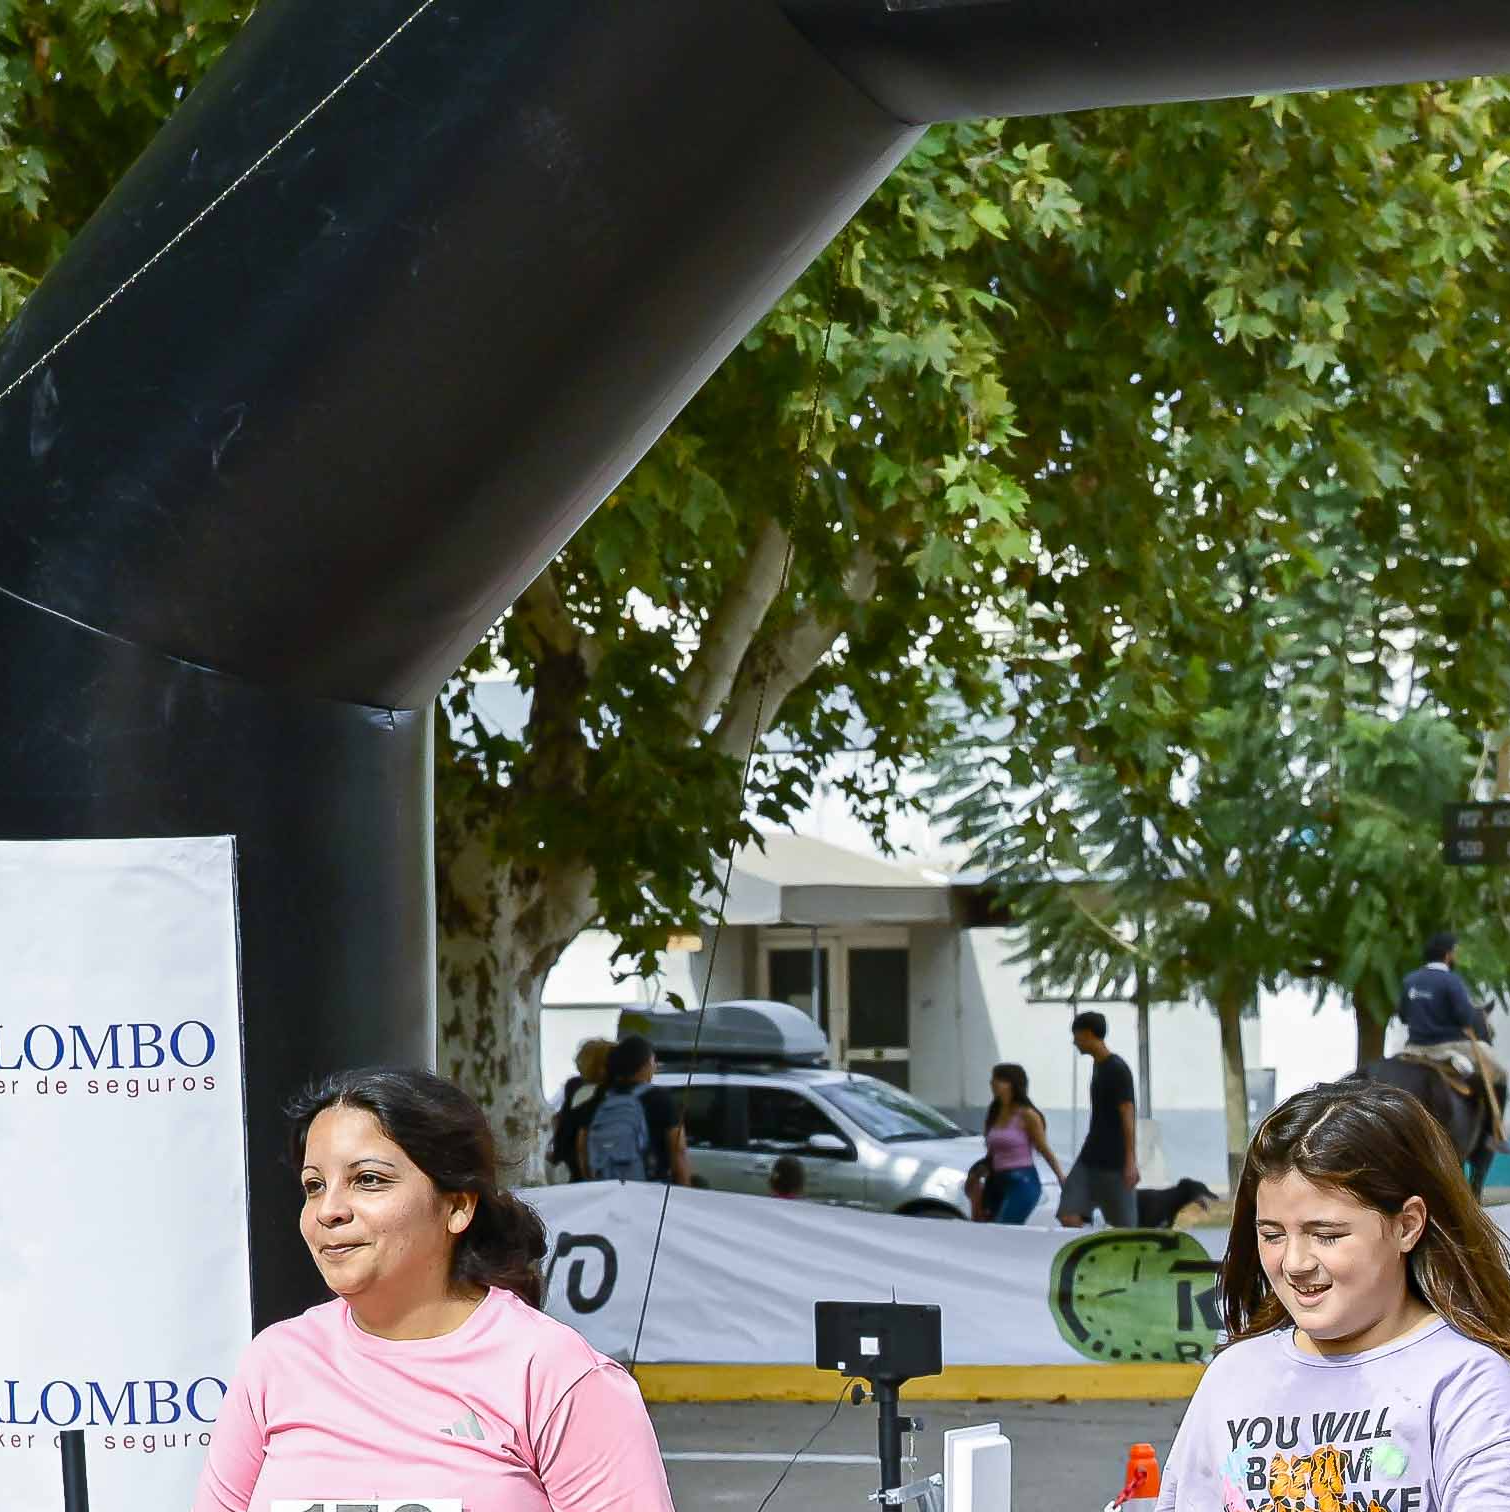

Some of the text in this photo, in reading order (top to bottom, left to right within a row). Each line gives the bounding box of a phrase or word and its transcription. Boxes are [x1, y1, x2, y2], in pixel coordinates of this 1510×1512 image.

[36, 1075, 68, 1095] de
[87, 1072, 217, 1098] seguros
[104, 1431, 212, 1454] seguro
[1226, 1406, 1392, 1453] YOU WILL
